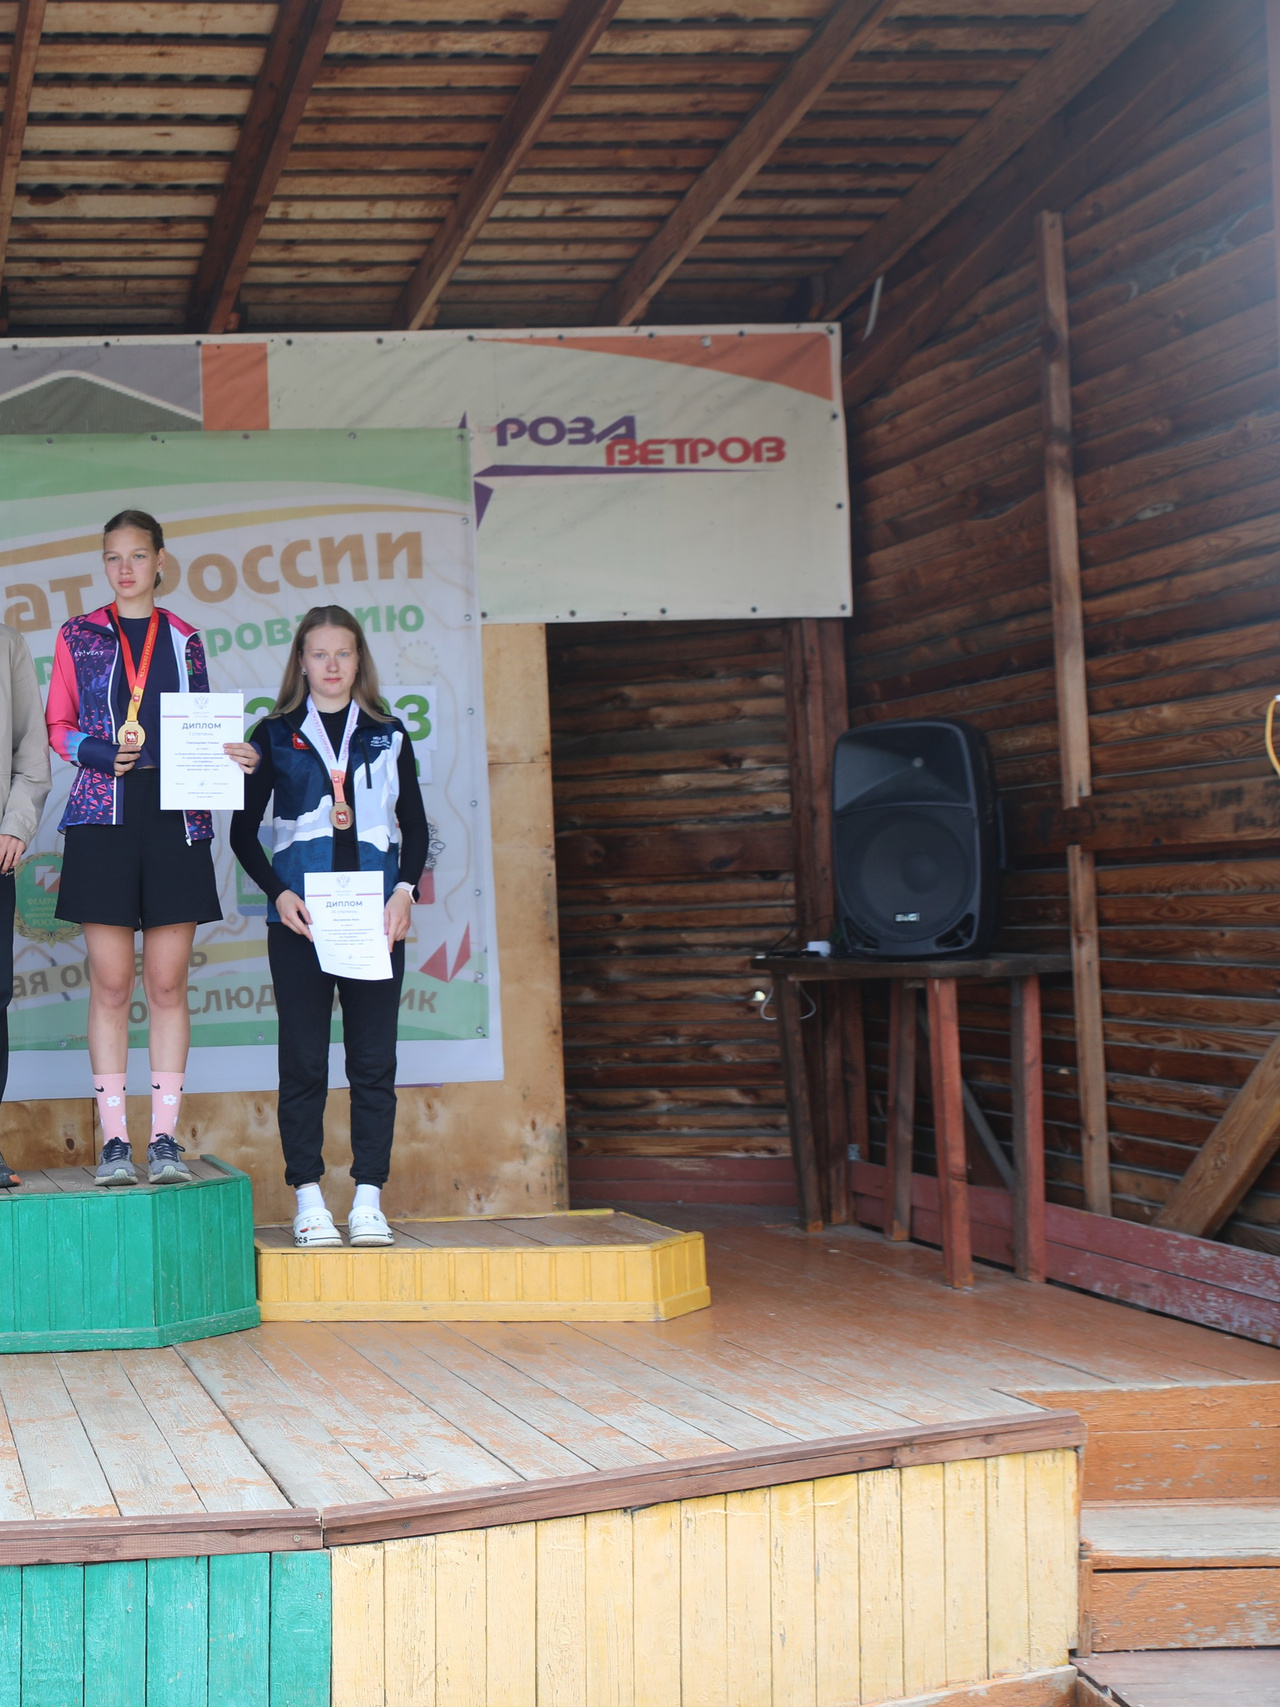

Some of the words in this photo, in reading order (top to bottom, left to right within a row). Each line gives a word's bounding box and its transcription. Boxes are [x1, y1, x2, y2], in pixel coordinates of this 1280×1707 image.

[496, 415, 636, 447] РОЗА
[605, 436, 786, 467] ВЕТРОВ
[182, 722, 221, 730] ДИПЛОМ
[325, 900, 363, 908] ДИПЛОМ
